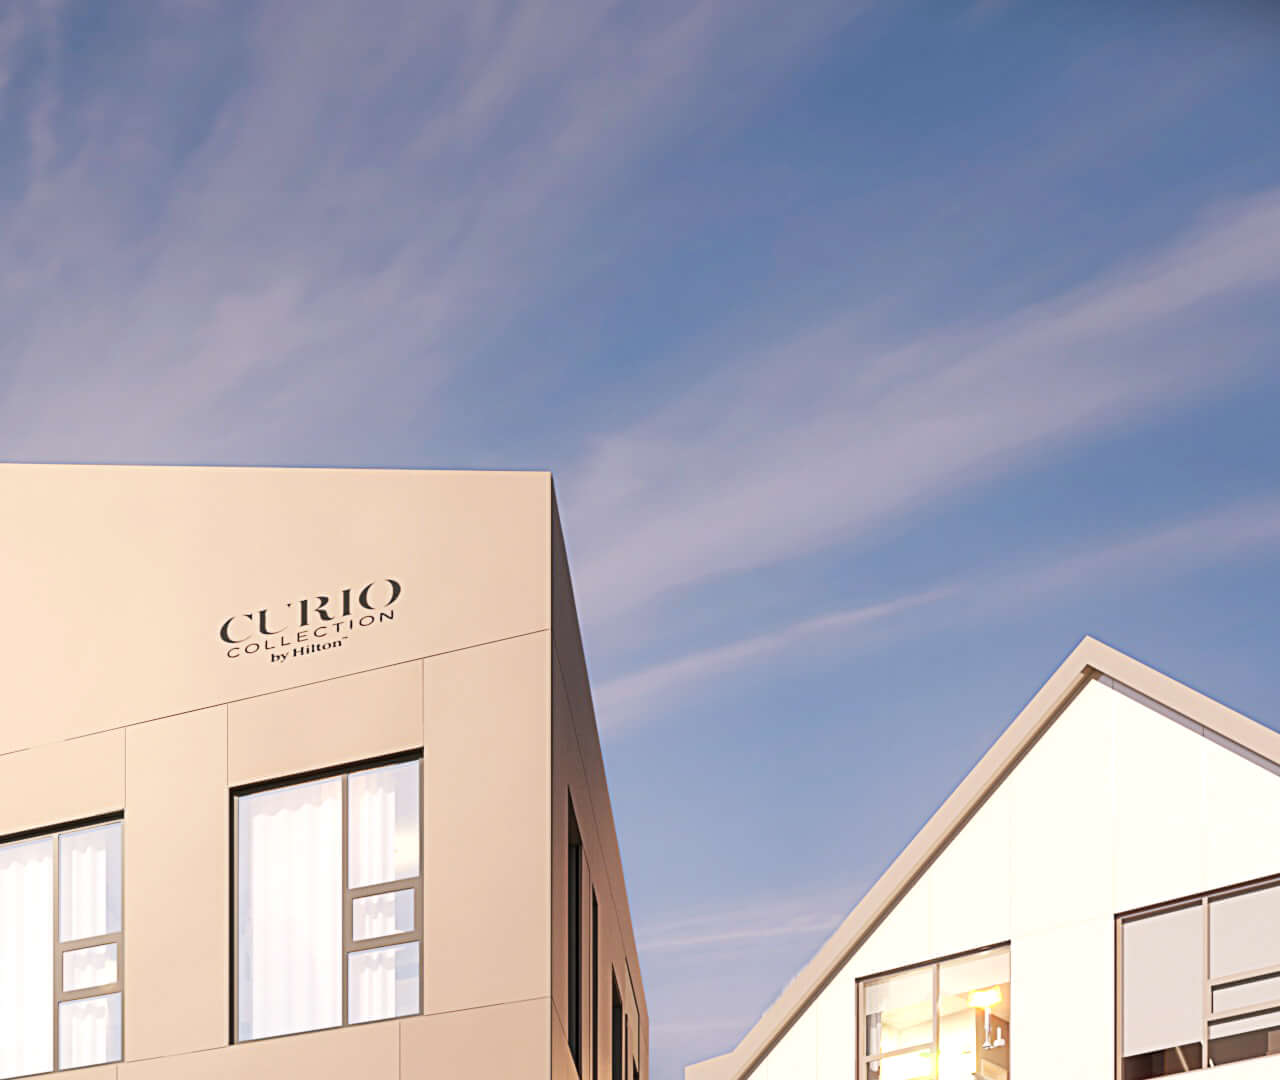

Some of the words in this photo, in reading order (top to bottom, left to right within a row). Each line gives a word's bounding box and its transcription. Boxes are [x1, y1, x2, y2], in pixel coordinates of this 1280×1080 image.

[219, 578, 402, 644] CURIO
[226, 610, 395, 658] COLLECTION
[271, 652, 289, 663] by
[293, 640, 342, 657] Hilton
